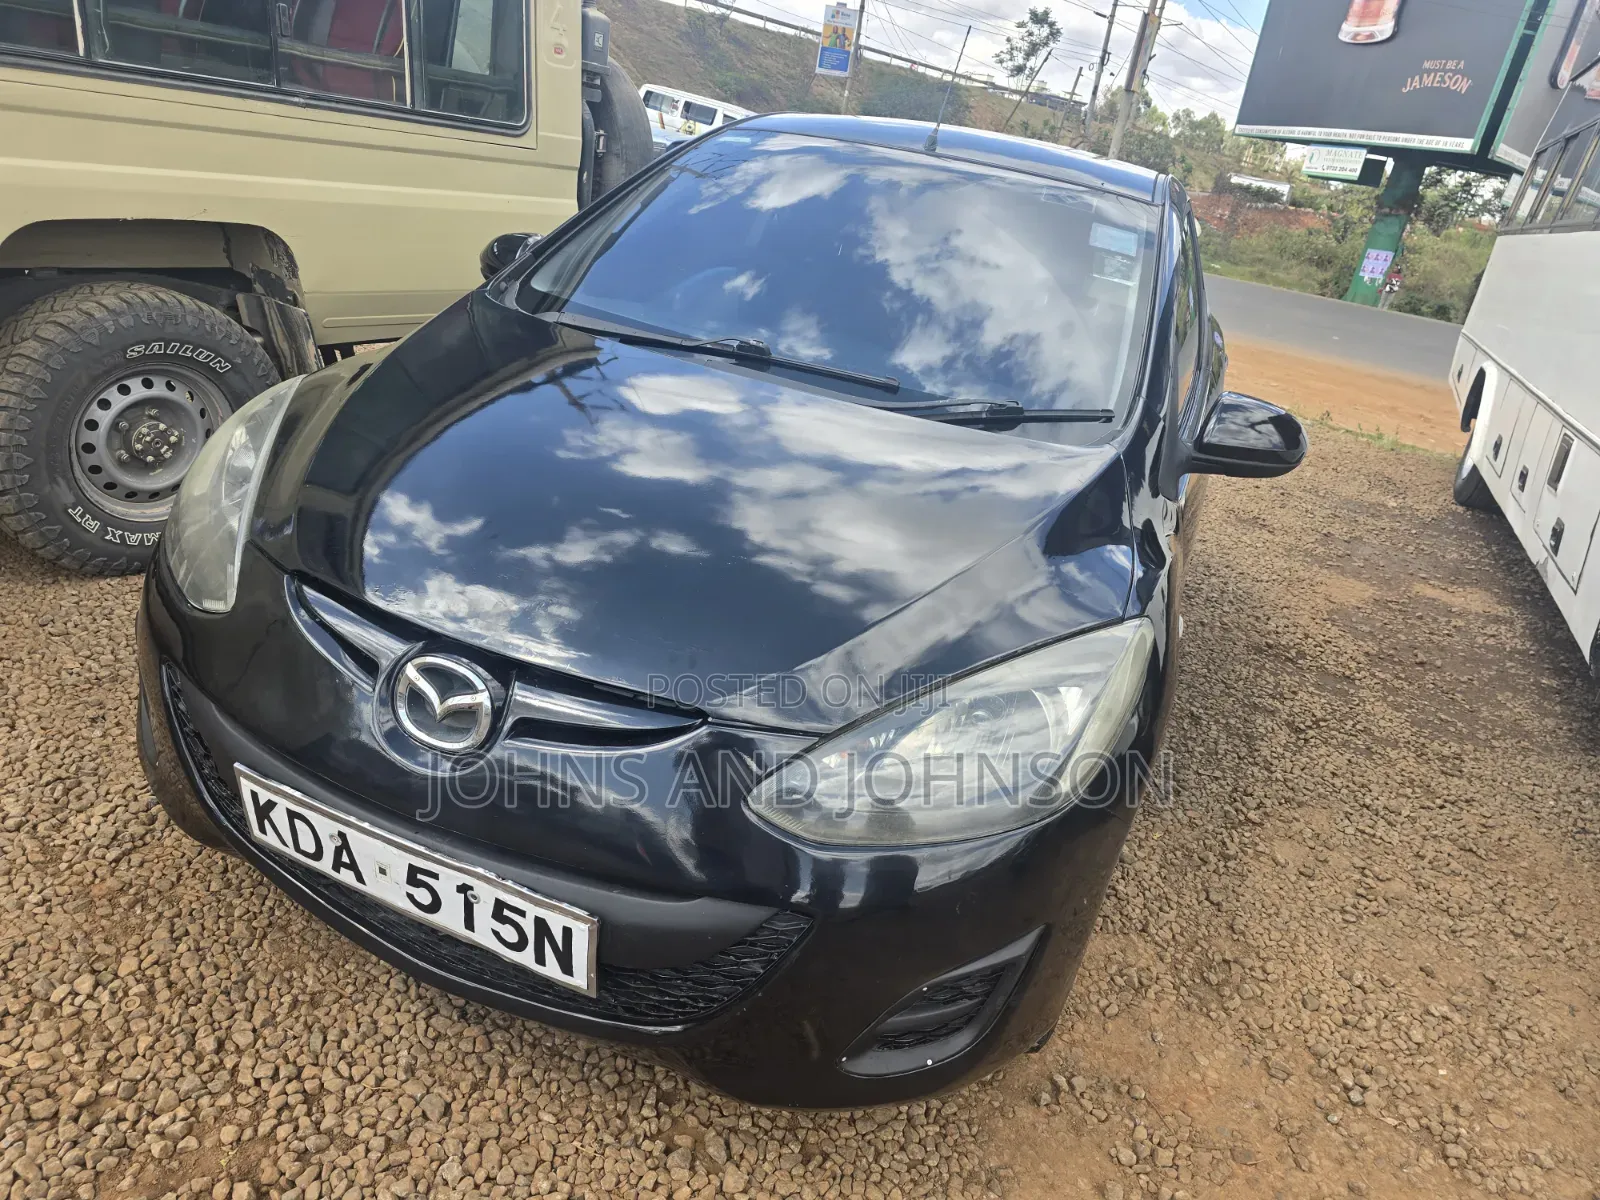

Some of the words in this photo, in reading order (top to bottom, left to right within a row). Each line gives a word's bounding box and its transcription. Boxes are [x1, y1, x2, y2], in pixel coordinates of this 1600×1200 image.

[1422, 60, 1446, 69] MUST
[1446, 60, 1458, 69] BE
[1457, 60, 1465, 69] A
[1402, 72, 1471, 94] JAMESON
[126, 342, 232, 373] SAILUN
[68, 506, 100, 533] RT
[249, 788, 367, 887] KDA
[405, 862, 575, 978] 515N
